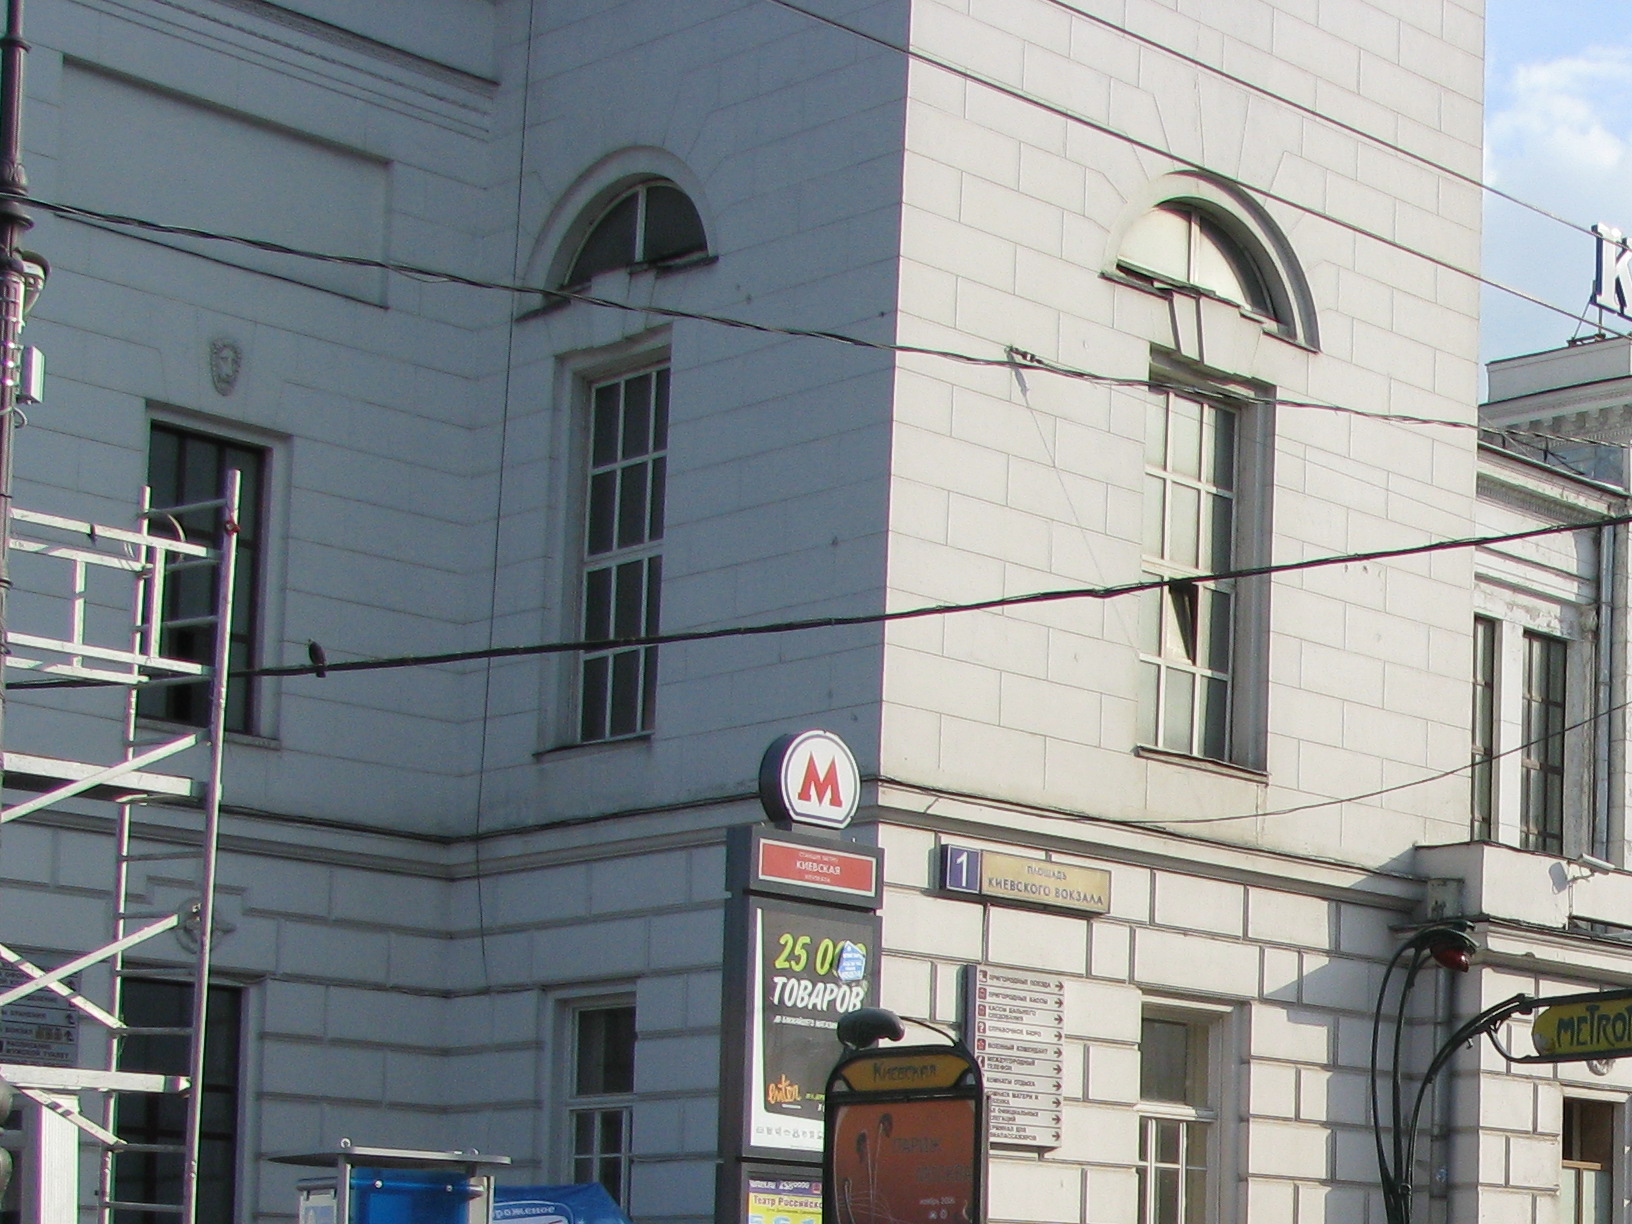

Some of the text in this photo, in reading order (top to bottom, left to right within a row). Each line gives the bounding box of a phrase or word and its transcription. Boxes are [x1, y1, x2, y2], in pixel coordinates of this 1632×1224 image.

[798, 751, 843, 808] М
[796, 860, 841, 876] КИЕВСКАЯ
[956, 851, 968, 888] 1
[1026, 865, 1067, 881] ПЛОЩАДЬ
[987, 877, 1104, 906] КИЕВСКОГО ВОКЗАЛА
[774, 933, 812, 972] 25
[773, 976, 865, 1013] ТОВАРОВ
[753, 1194, 776, 1207] Театр
